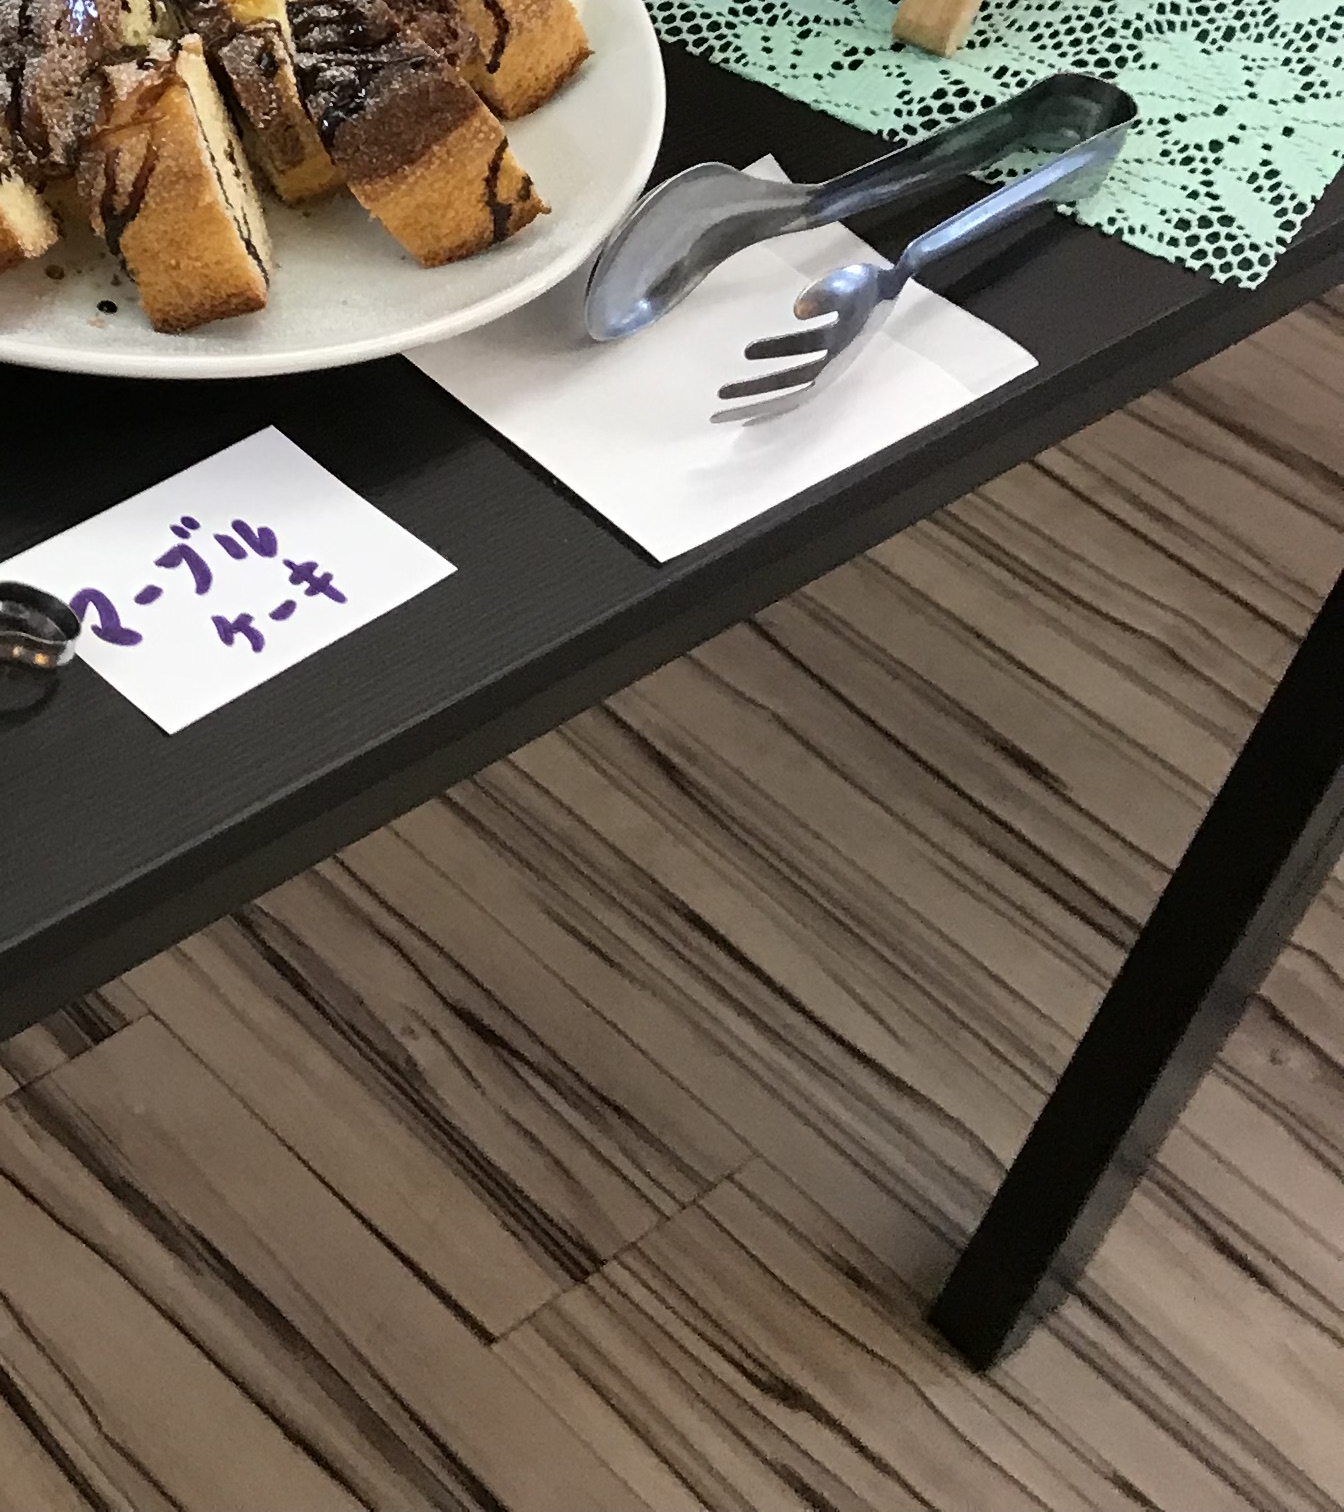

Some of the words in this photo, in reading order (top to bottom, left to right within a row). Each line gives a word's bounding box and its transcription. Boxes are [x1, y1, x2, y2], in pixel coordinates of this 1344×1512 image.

[69, 514, 280, 648] マーブル
[210, 558, 349, 654] ケーキ
